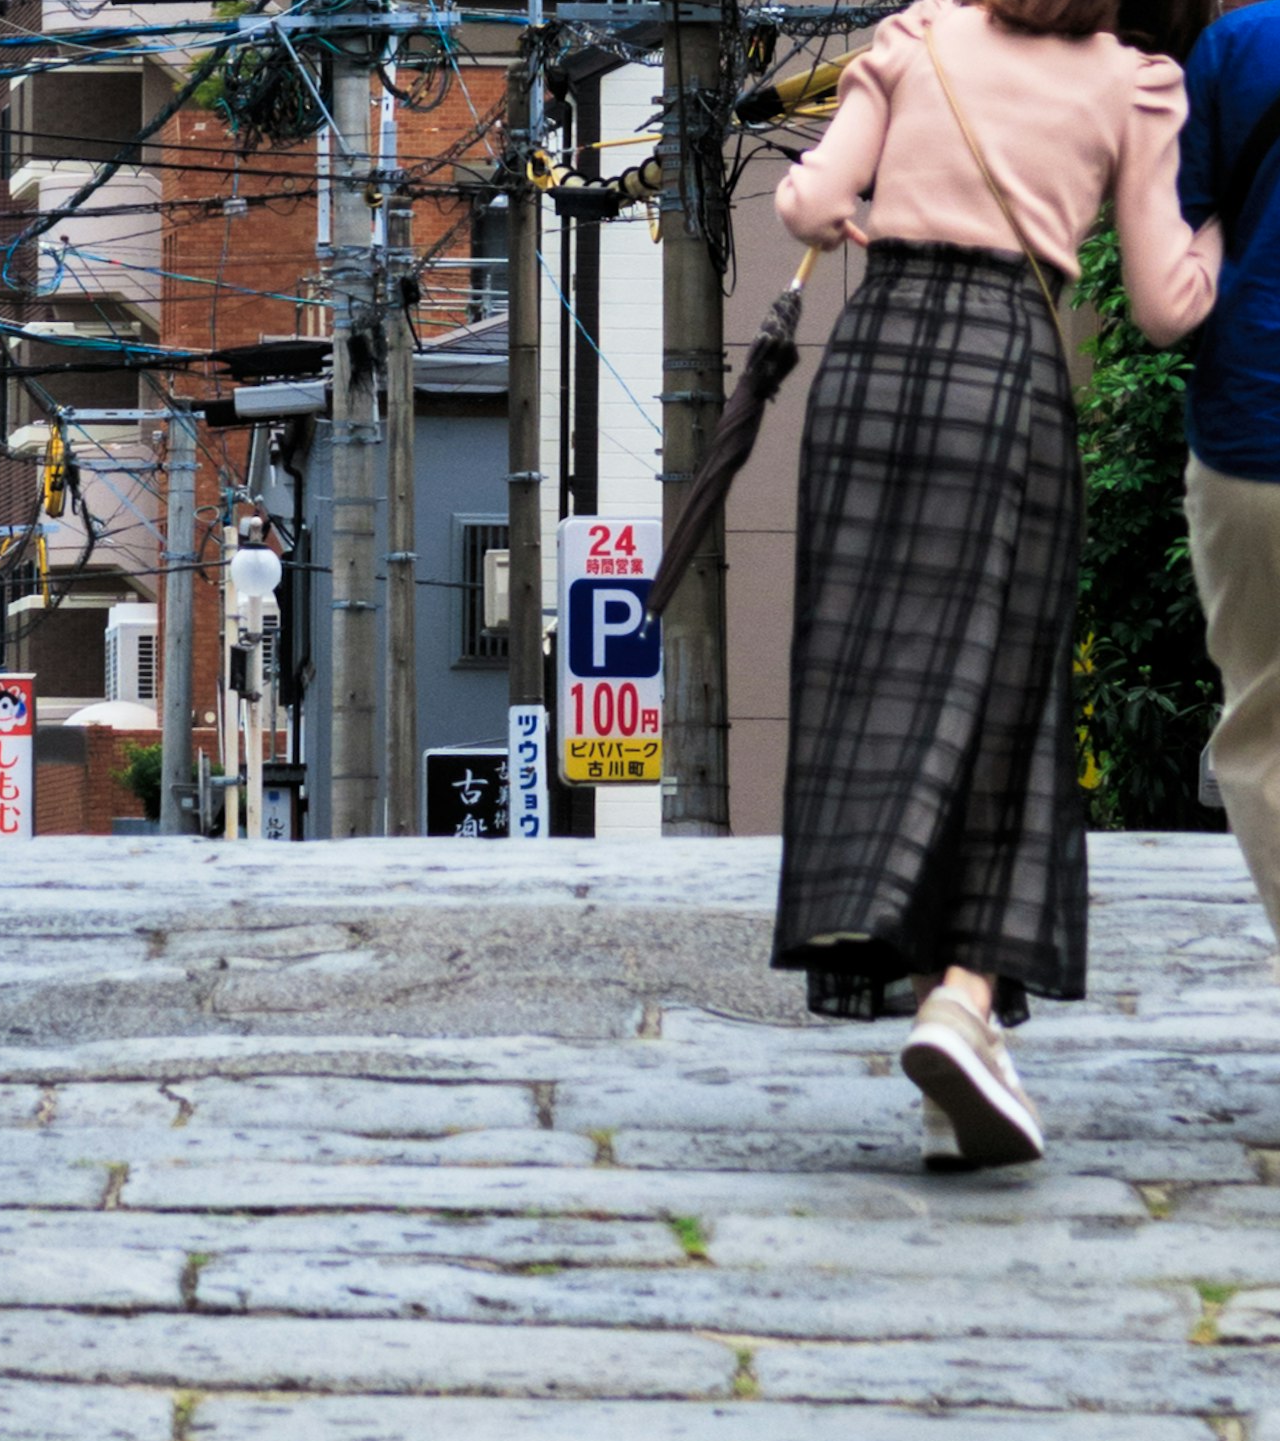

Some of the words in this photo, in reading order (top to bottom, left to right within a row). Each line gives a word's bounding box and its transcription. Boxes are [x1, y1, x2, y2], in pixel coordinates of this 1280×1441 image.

[588, 524, 637, 557] 24
[585, 558, 644, 575] 時間営業
[592, 588, 643, 668] P
[571, 682, 659, 737] 100円
[587, 760, 645, 778] 古川町
